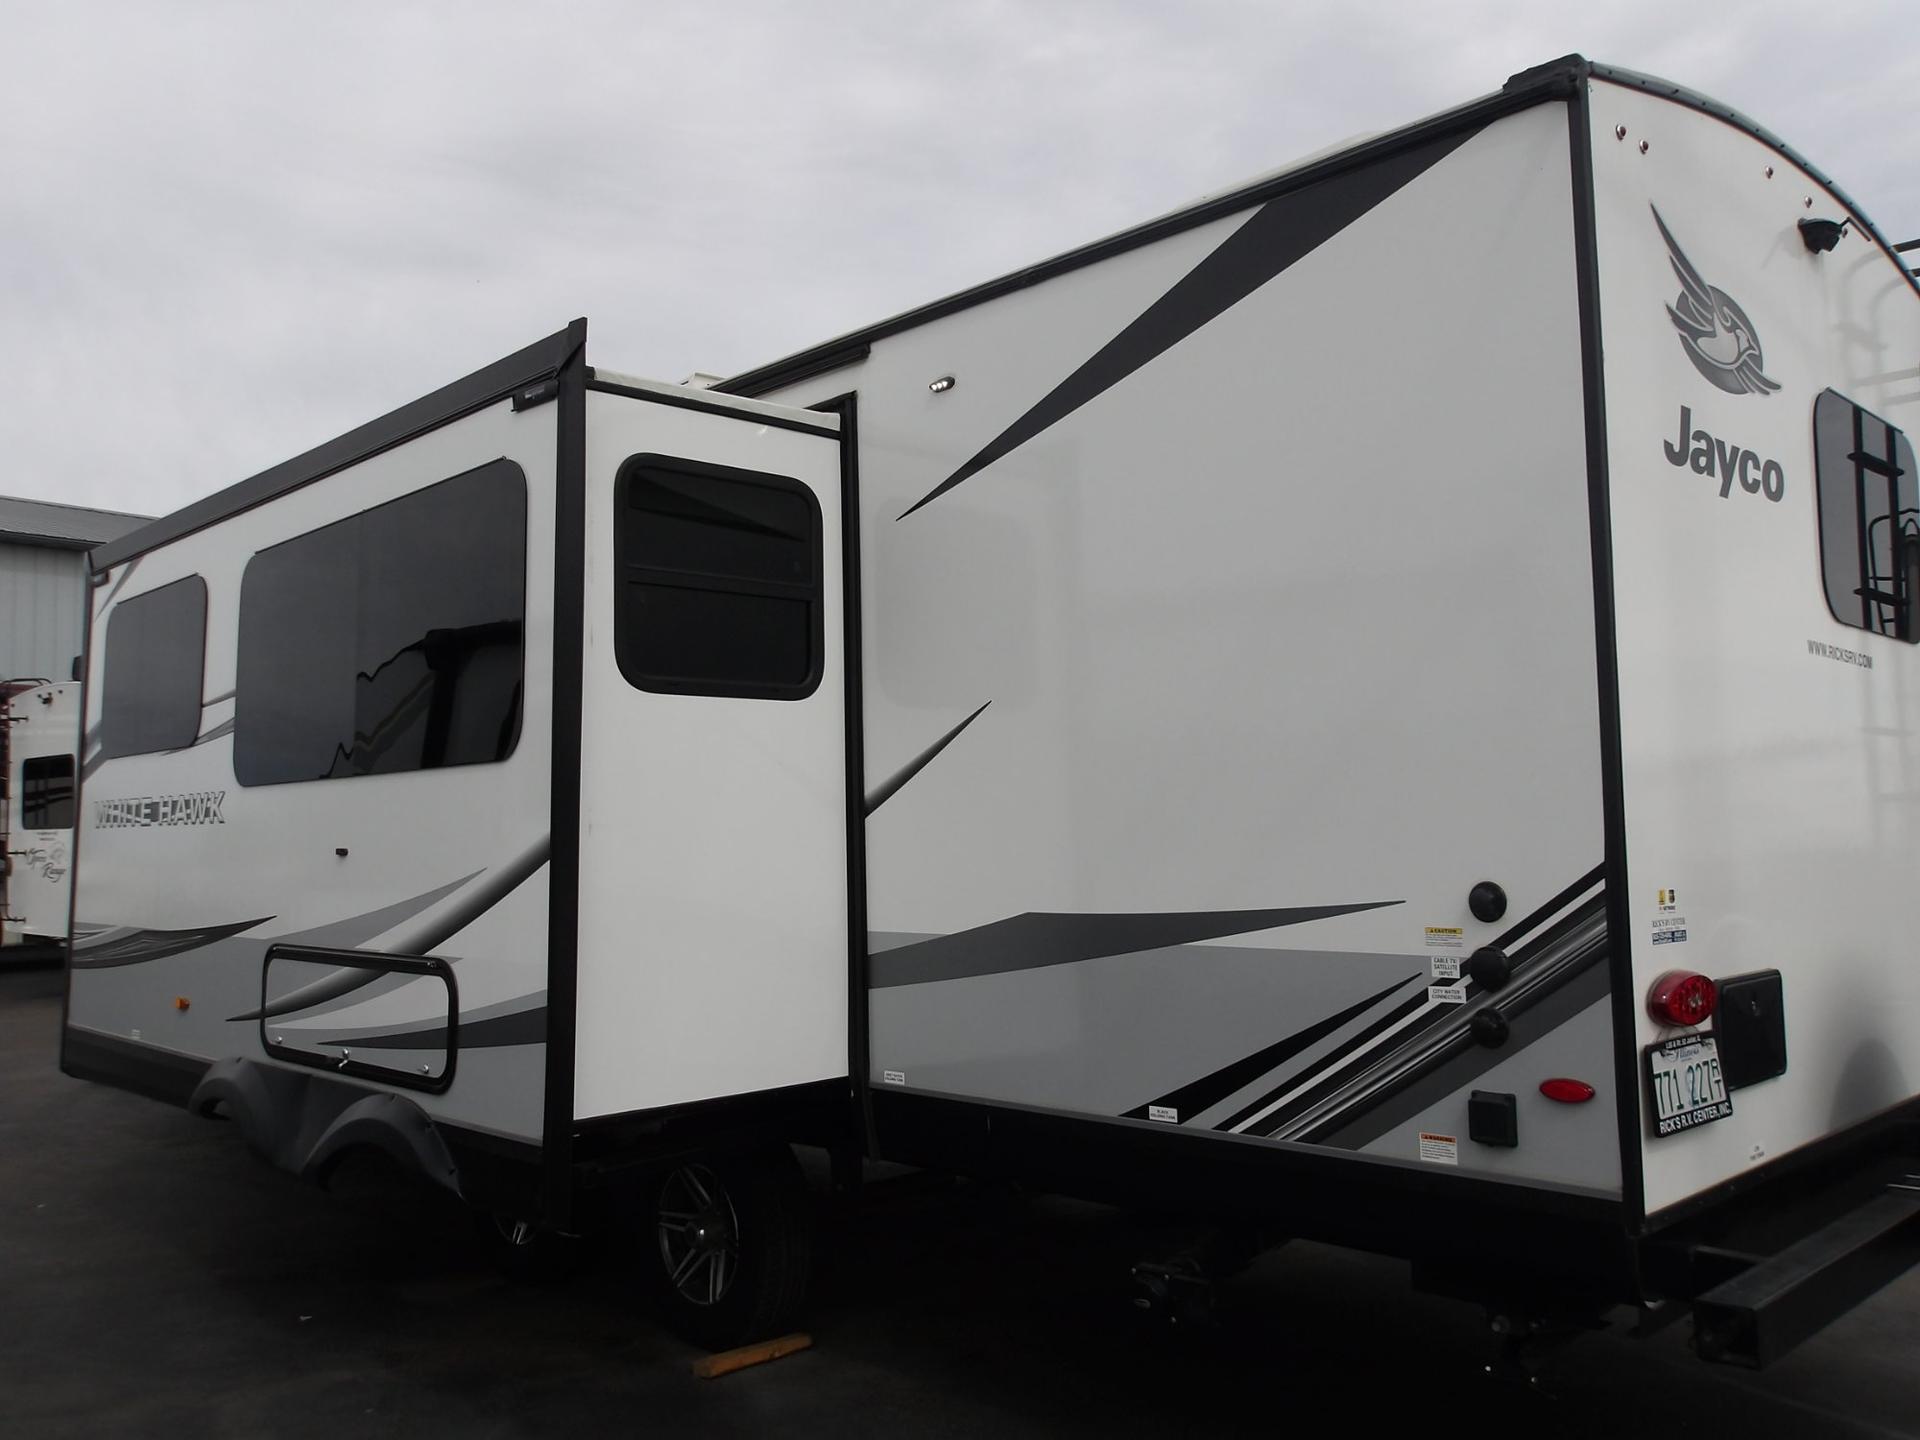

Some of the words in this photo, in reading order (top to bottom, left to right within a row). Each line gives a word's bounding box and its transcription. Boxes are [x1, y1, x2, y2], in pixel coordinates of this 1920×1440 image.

[1663, 404, 1785, 503] Jayco
[93, 796, 154, 829] WHITE
[157, 790, 226, 826] HAWK
[1653, 1068, 1685, 1116] 771
[1687, 1060, 1714, 1106] 227
[1659, 1116, 1682, 1134] RICK'S
